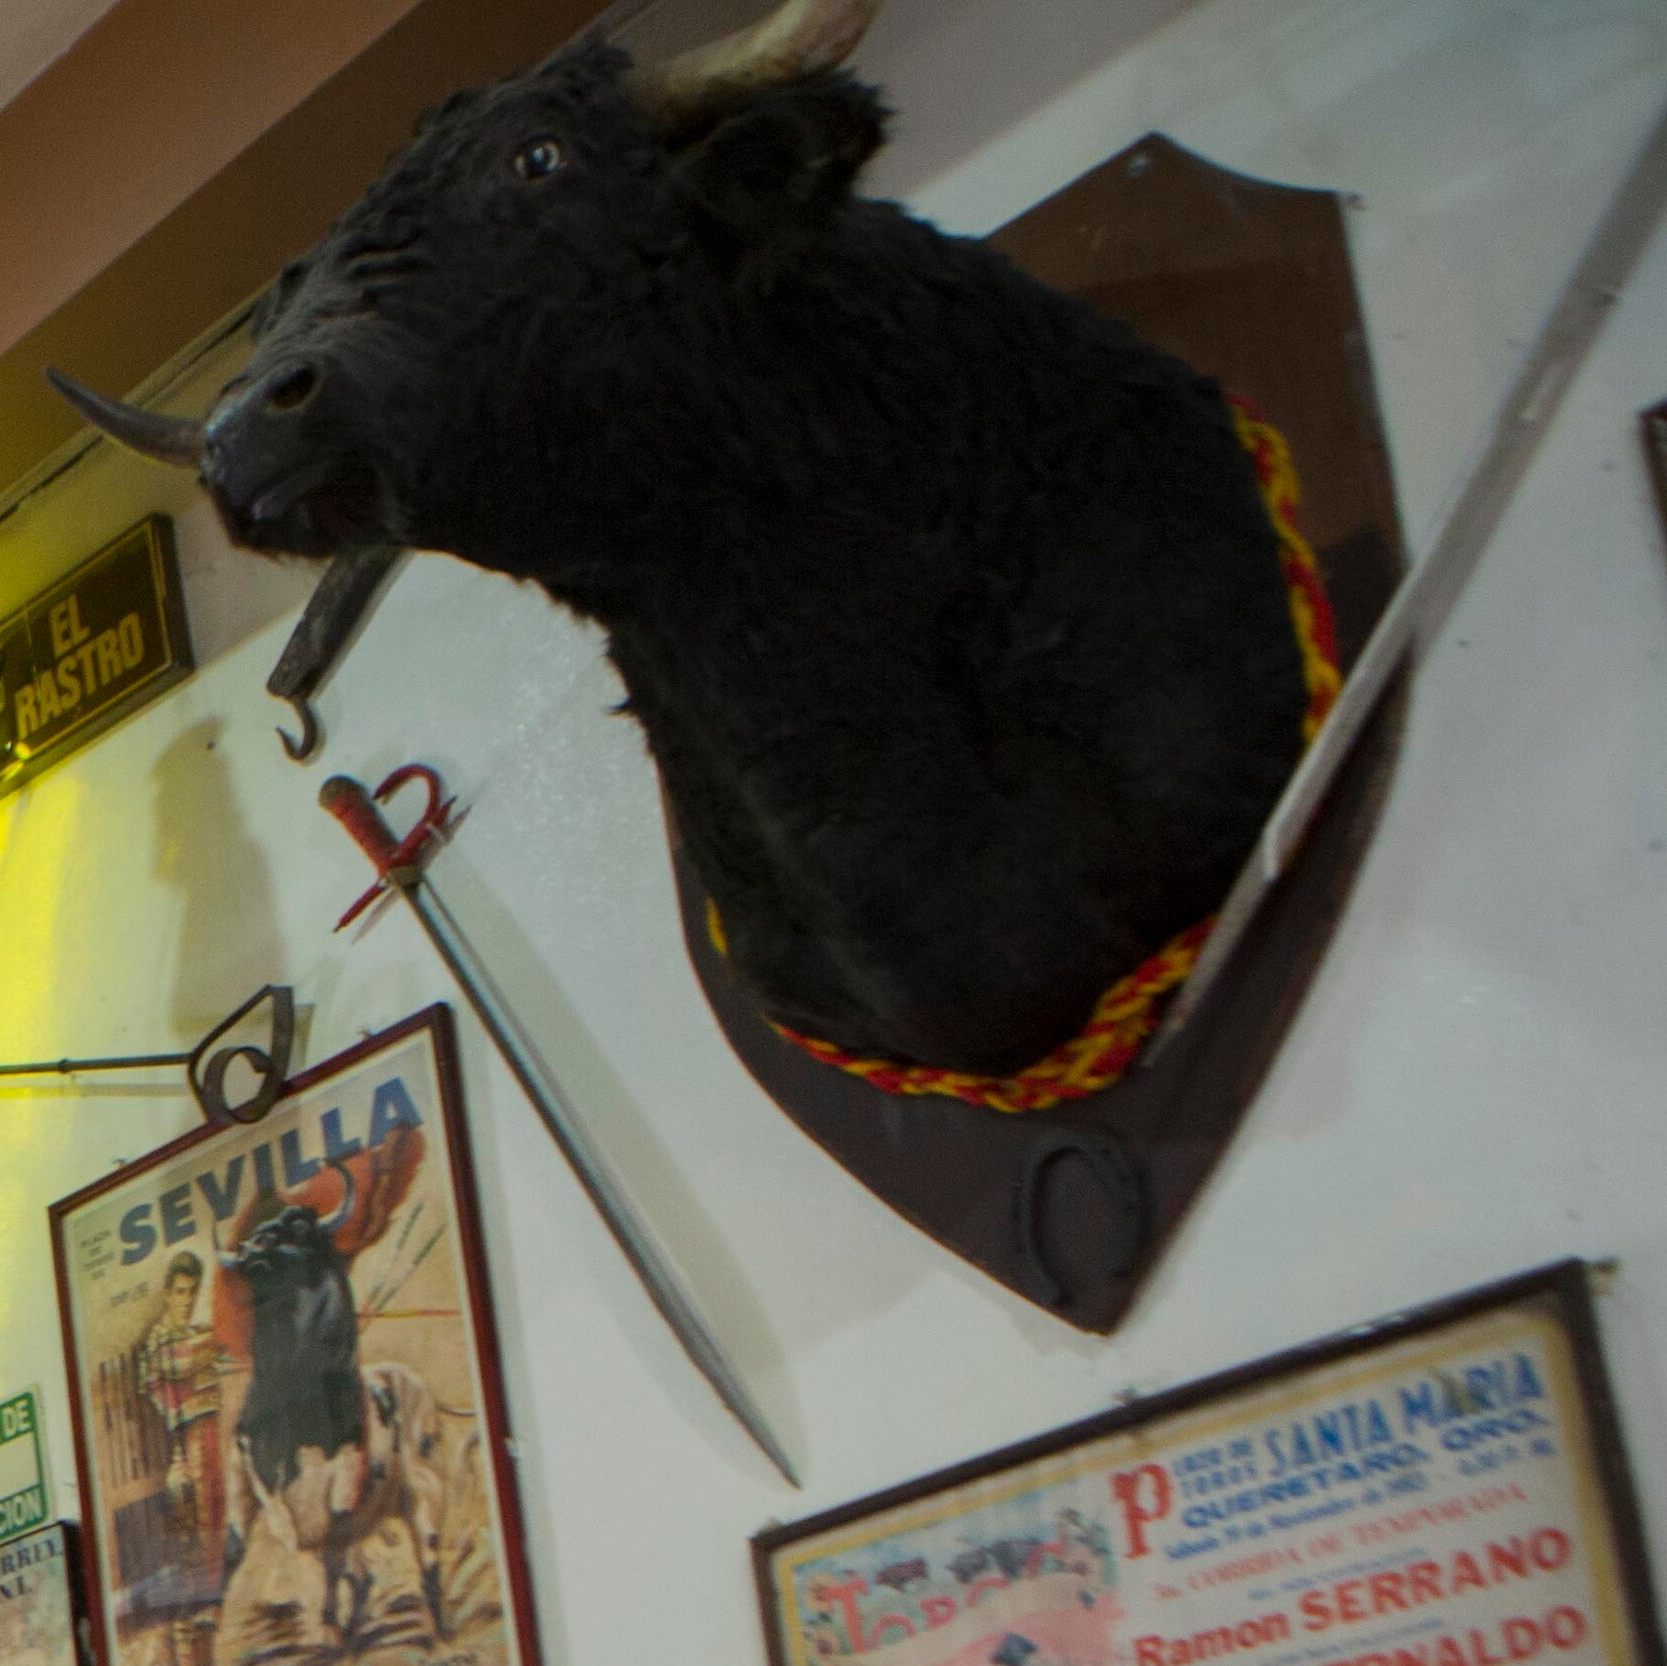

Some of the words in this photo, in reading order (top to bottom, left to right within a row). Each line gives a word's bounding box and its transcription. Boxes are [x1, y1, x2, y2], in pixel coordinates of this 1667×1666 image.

[51, 594, 90, 656] EL
[16, 612, 144, 739] RASTRO
[119, 1077, 423, 1266] SEVILLA
[1, 1399, 32, 1439] DE
[1266, 1400, 1391, 1477] SANTA
[1298, 1526, 1573, 1634] SERRANO
